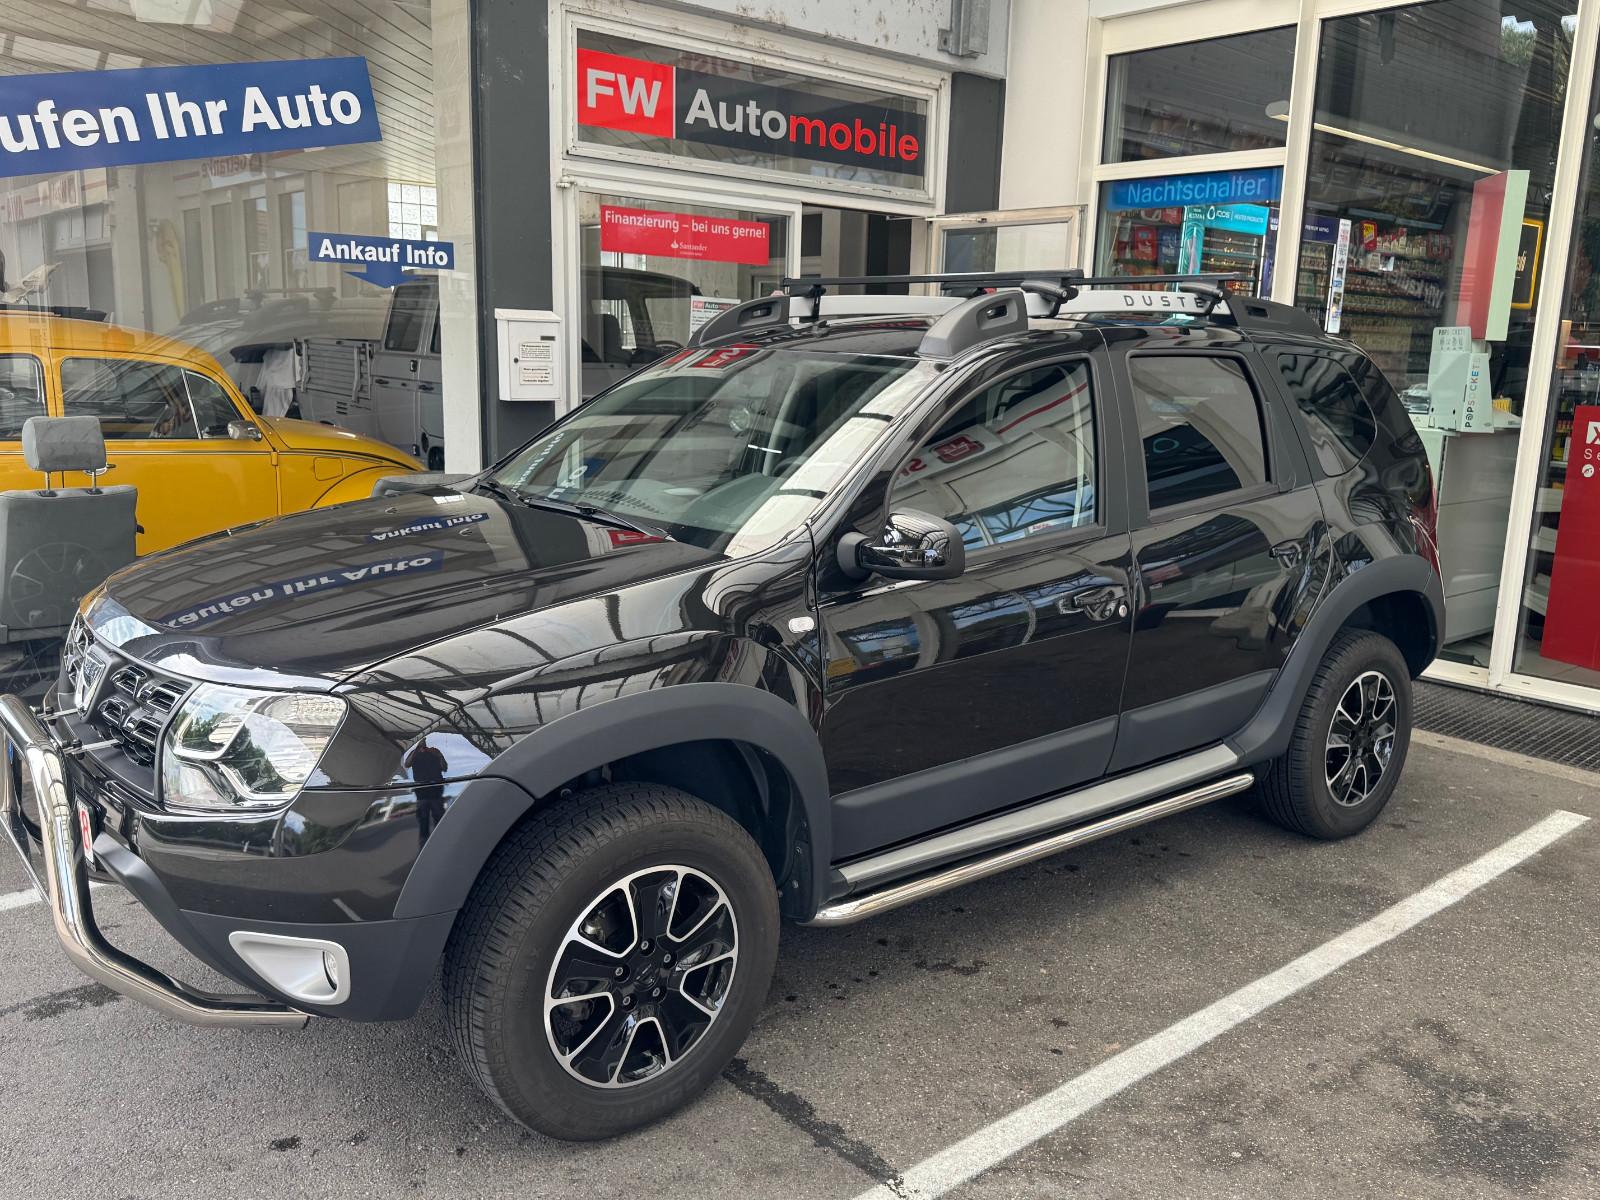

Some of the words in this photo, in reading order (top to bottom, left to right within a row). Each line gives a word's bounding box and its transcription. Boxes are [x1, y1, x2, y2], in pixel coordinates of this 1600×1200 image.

[146, 91, 228, 139] Ihr
[242, 84, 362, 133] Auto
[586, 67, 662, 119] FW
[684, 88, 919, 161] Automobile
[1127, 176, 1267, 204] Nachtschalter
[605, 210, 680, 233] Finanzierung
[691, 219, 708, 233] bei
[711, 223, 730, 236] uns
[732, 226, 766, 239] gerne!
[318, 238, 400, 263] Ankauf
[406, 244, 449, 266] Info
[679, 242, 708, 252] Santander
